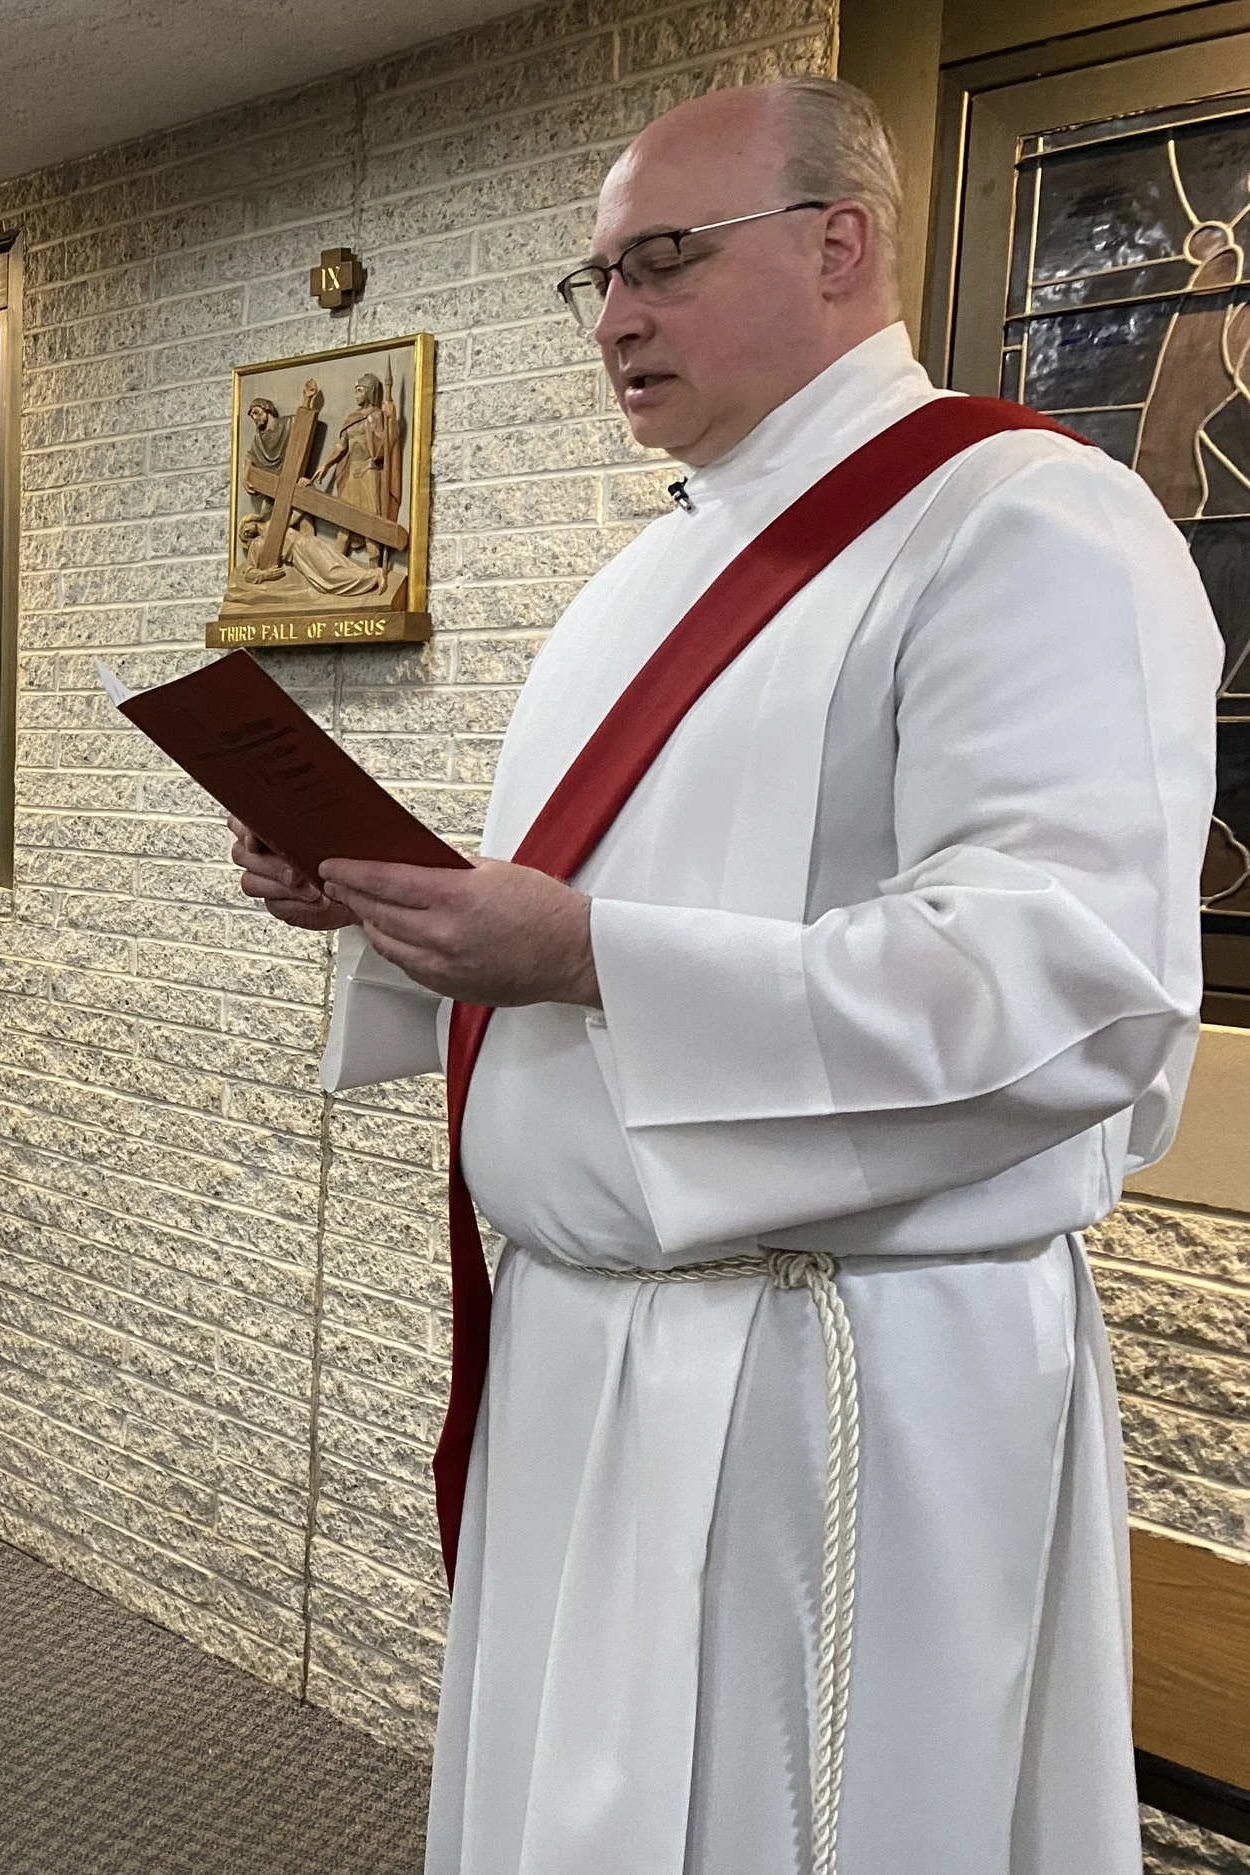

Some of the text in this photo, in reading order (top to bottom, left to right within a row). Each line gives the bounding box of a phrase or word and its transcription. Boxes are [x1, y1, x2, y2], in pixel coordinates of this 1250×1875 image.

[321, 266, 340, 291] IX
[219, 619, 386, 642] THIRD FALL OF JESUS
